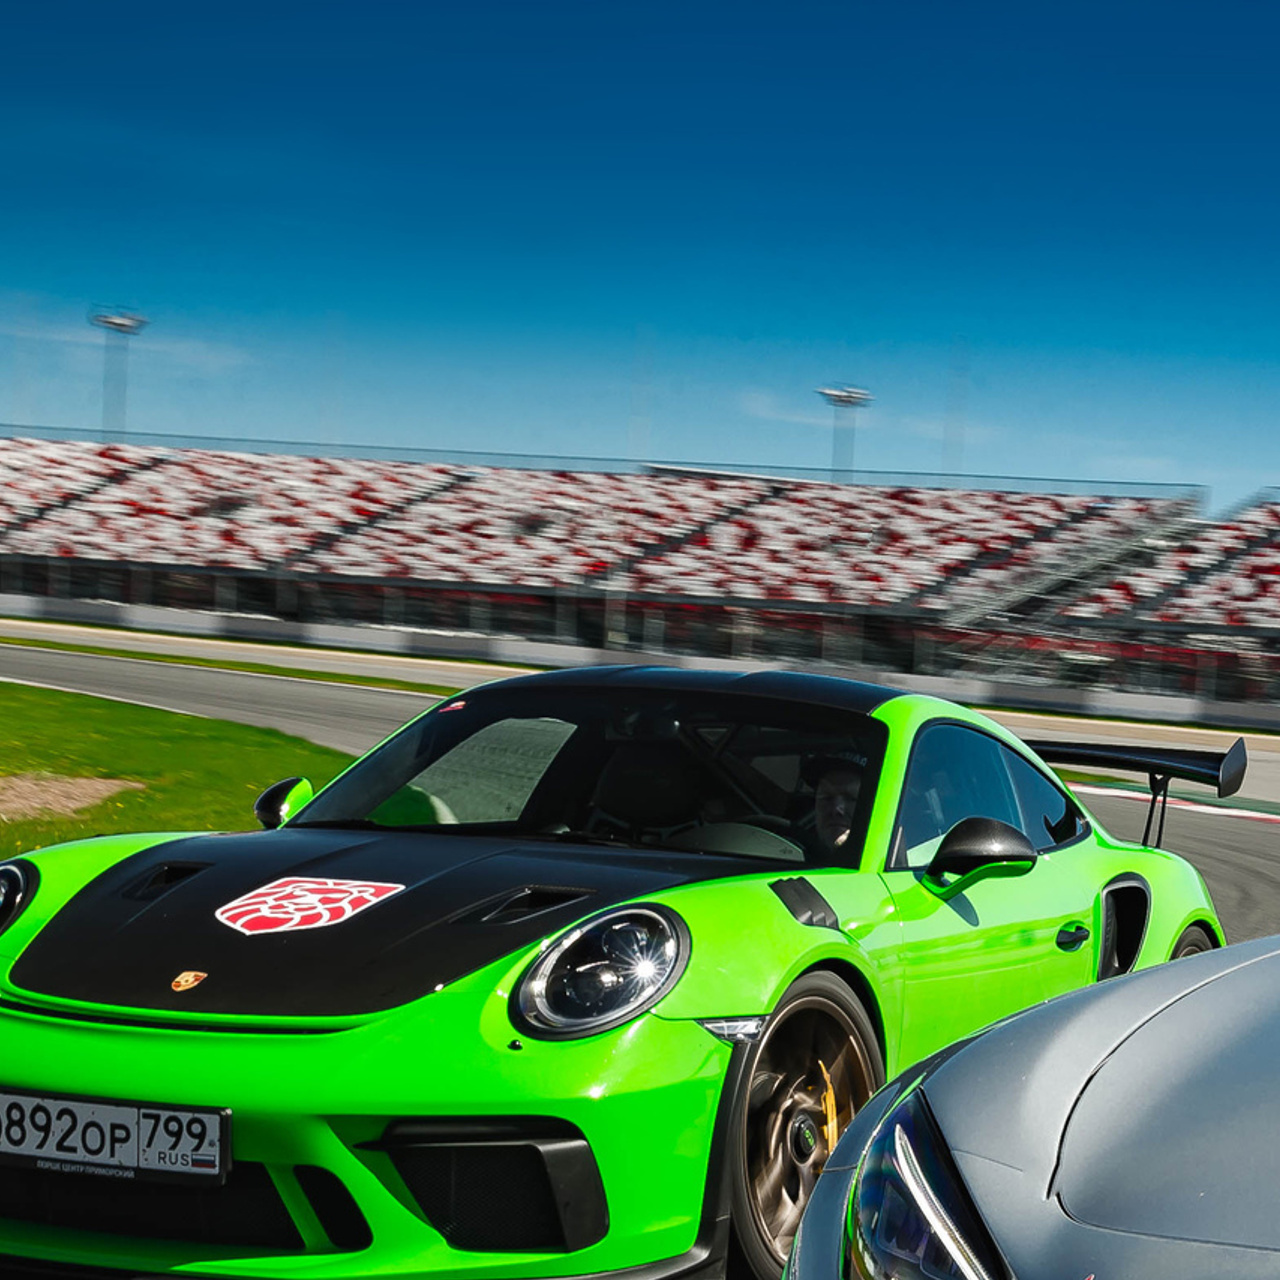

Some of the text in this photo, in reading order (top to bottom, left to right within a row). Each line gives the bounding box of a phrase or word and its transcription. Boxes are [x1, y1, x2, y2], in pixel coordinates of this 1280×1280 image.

[0, 1101, 207, 1158] 892ОР 799
[157, 1151, 190, 1167] RUS
